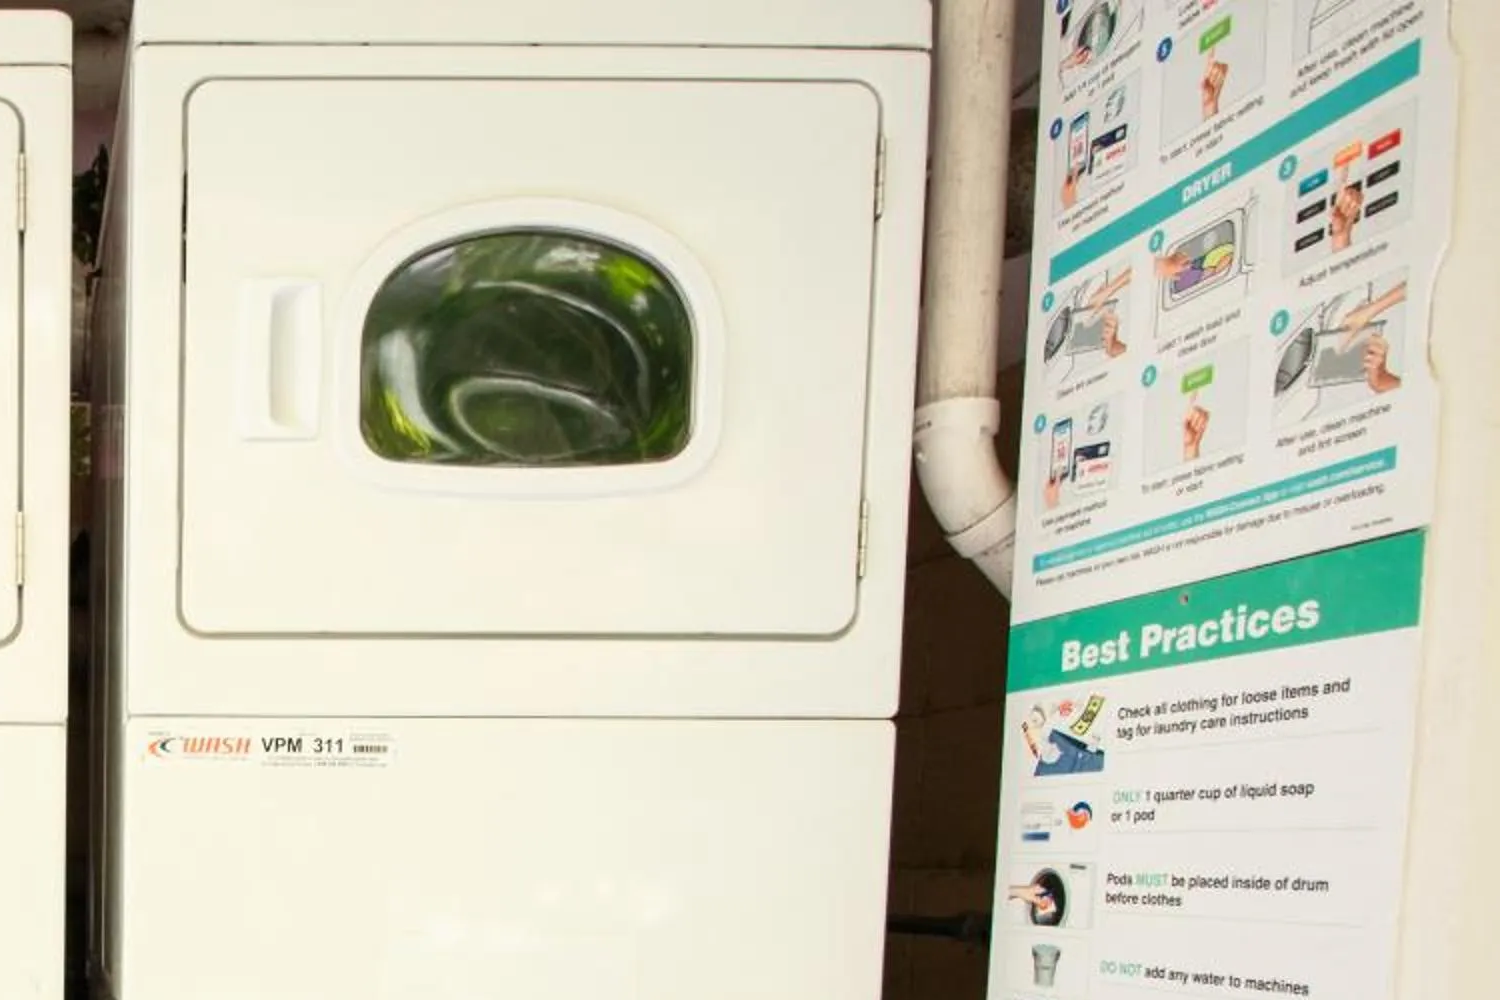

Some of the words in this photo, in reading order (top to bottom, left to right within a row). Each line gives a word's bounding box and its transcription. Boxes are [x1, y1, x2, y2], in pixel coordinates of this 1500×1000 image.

[1182, 162, 1233, 204] DRYER
[1061, 638, 1130, 672] Best
[1140, 599, 1320, 658] Practices
[1117, 704, 1151, 720] Check
[1154, 702, 1167, 716] all
[1170, 696, 1217, 715] clothing
[1221, 692, 1238, 708] for
[1241, 689, 1278, 706] loose
[1281, 683, 1319, 700] items
[1322, 678, 1351, 695] and
[1116, 726, 1133, 741] tag
[1136, 723, 1151, 738] for
[1153, 718, 1197, 736] laundry
[1200, 716, 1226, 730] care
[1230, 706, 1309, 728] instructions
[181, 737, 251, 755] WASH
[261, 737, 303, 752] VPM
[313, 738, 344, 753] 311
[1153, 787, 1195, 806] quarter
[1198, 787, 1220, 804] cup
[1224, 784, 1238, 799] of
[1240, 782, 1277, 800] liquid
[1280, 782, 1314, 798] soap
[1111, 811, 1122, 822] or
[1133, 809, 1155, 824] pod
[1107, 873, 1132, 887] Pods
[1134, 874, 1168, 888] MUST
[1171, 874, 1184, 888] be
[1188, 876, 1229, 891] placed
[1231, 876, 1270, 890] inside
[1274, 877, 1288, 890] of
[1291, 878, 1329, 892] drum
[1106, 892, 1139, 905] before
[1141, 893, 1182, 908] clothes
[1100, 960, 1118, 974] DO
[1119, 962, 1142, 978] NOT
[1144, 967, 1166, 980] add
[1168, 970, 1189, 984] any
[1192, 972, 1225, 987] water
[1228, 976, 1241, 988] to
[1244, 978, 1309, 996] machines
